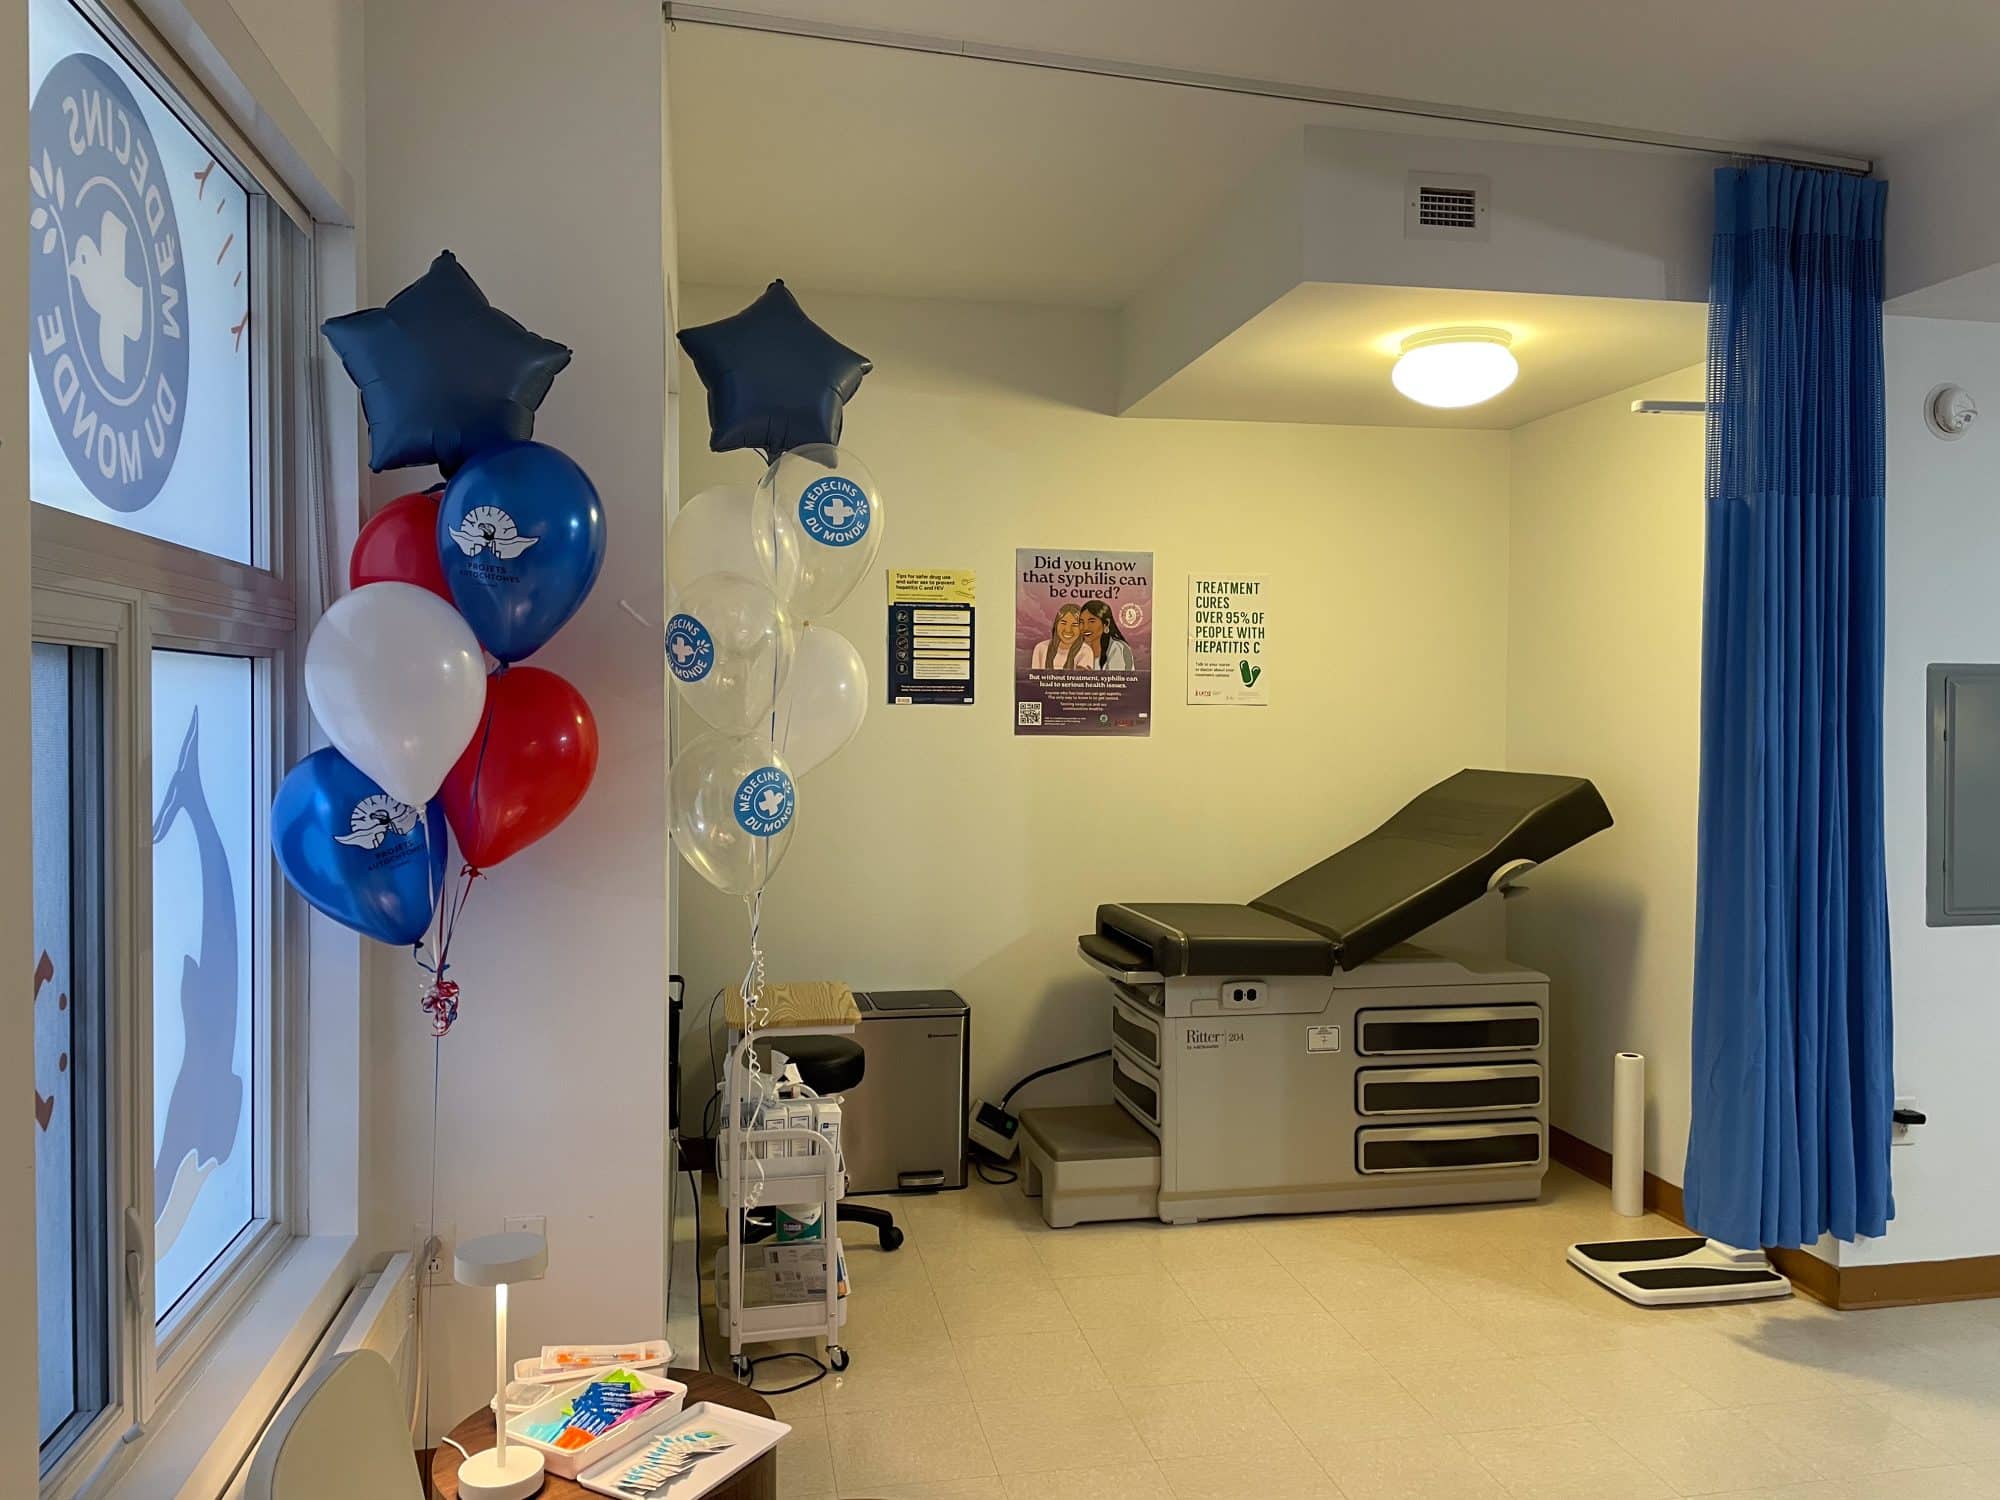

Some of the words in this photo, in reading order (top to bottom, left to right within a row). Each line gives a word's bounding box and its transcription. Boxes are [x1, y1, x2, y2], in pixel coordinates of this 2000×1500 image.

[803, 480, 858, 511] MÉDECINS
[805, 517, 823, 533] DU
[823, 520, 865, 542] MONDE
[1034, 555, 1060, 569] Did
[1063, 559, 1091, 572] you
[1094, 557, 1136, 571] know
[1023, 570, 1055, 583] that
[1057, 571, 1117, 587] syphilis
[1119, 575, 1148, 586] can
[1049, 585, 1068, 598] be
[1070, 586, 1121, 599] cured?
[1195, 581, 1261, 595] TREATMENT
[1195, 596, 1230, 609] CURES
[1195, 611, 1223, 624] OVER
[1225, 611, 1250, 625] 95%
[1251, 612, 1265, 625] OF
[1195, 625, 1234, 639] PEOPLE
[1236, 626, 1265, 639] WITH
[1195, 640, 1250, 654] HEPATITIS
[1253, 641, 1260, 654] C
[1040, 673, 1066, 681] without
[1100, 674, 1126, 683] syphilis
[738, 771, 781, 812] MÉDECINS
[744, 816, 763, 831] DU
[763, 799, 794, 833] MONDE
[1186, 1029, 1219, 1044] Ritter
